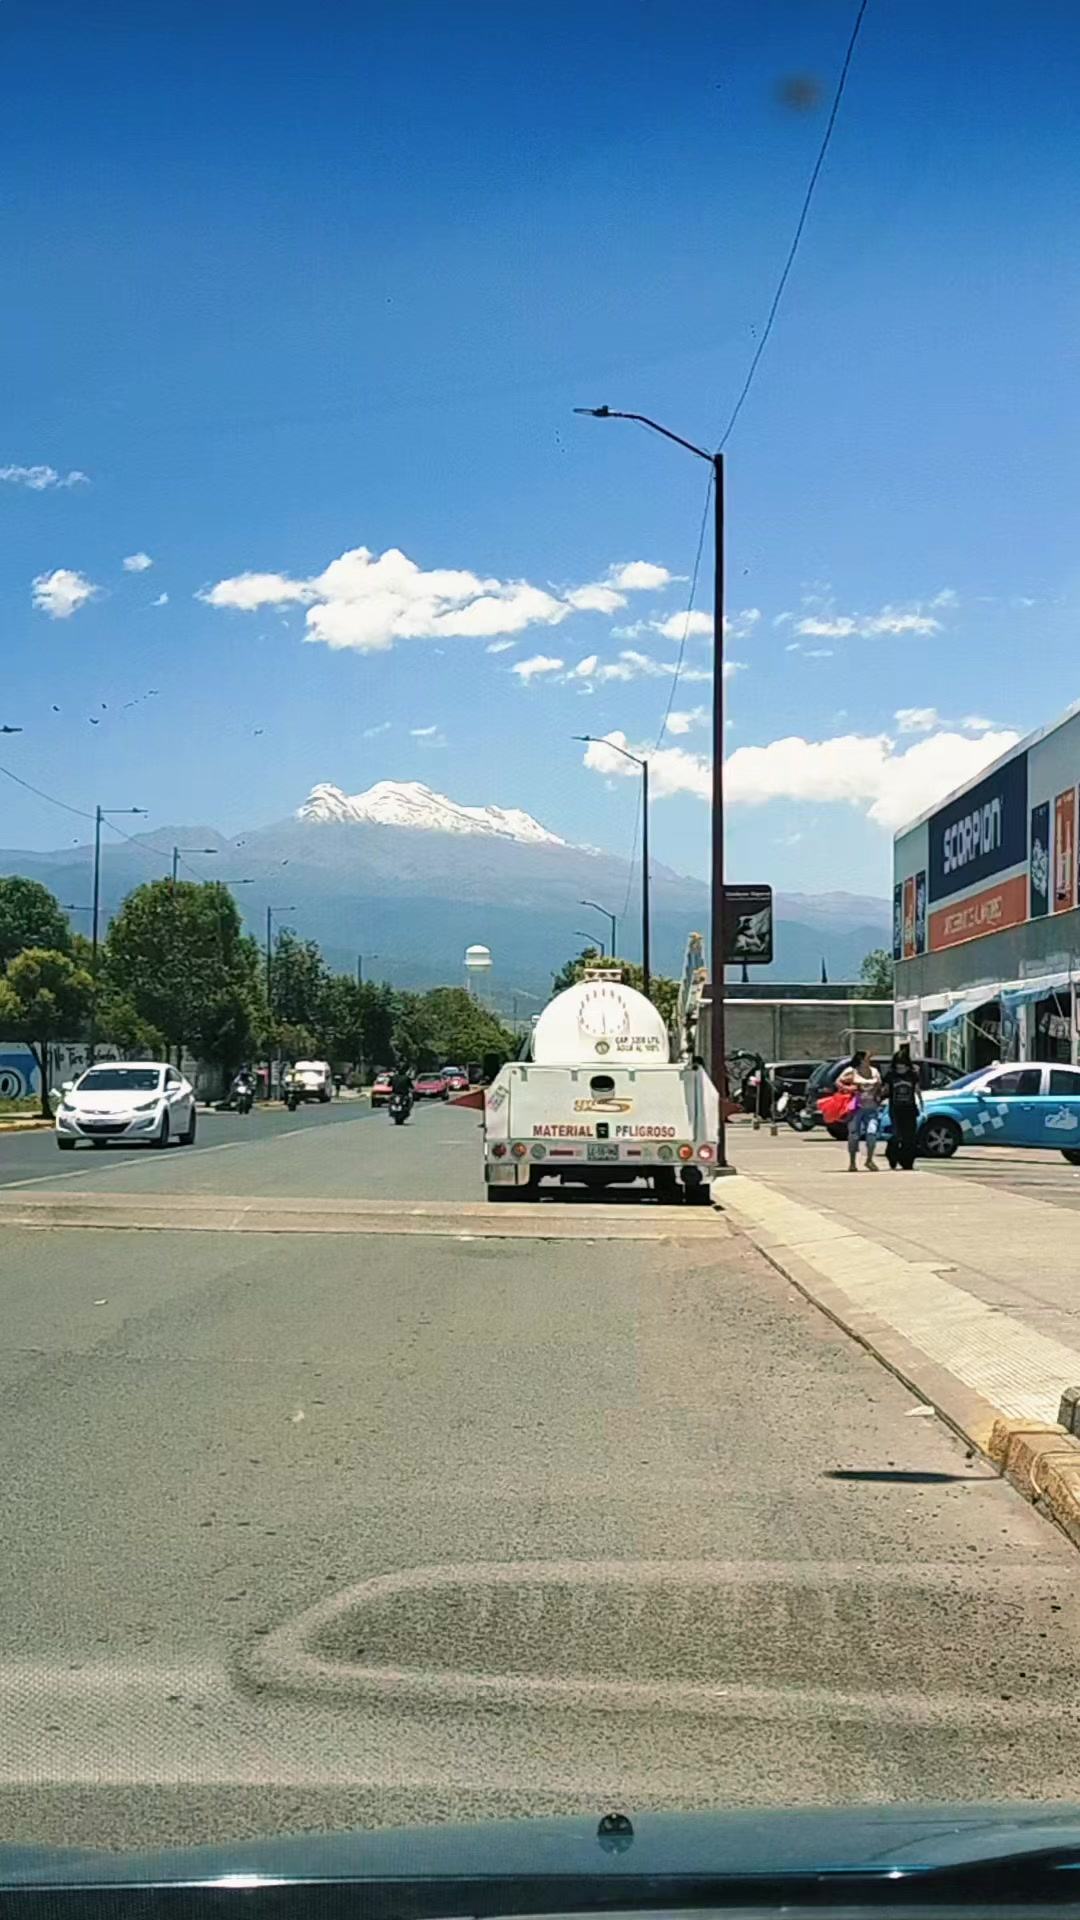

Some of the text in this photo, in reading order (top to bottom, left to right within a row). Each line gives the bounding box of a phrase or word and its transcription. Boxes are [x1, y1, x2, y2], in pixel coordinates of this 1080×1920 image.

[943, 797, 1001, 875] SCORPION
[533, 1125, 593, 1137] MATERIAL
[616, 1125, 676, 1137] PELIGROSO
